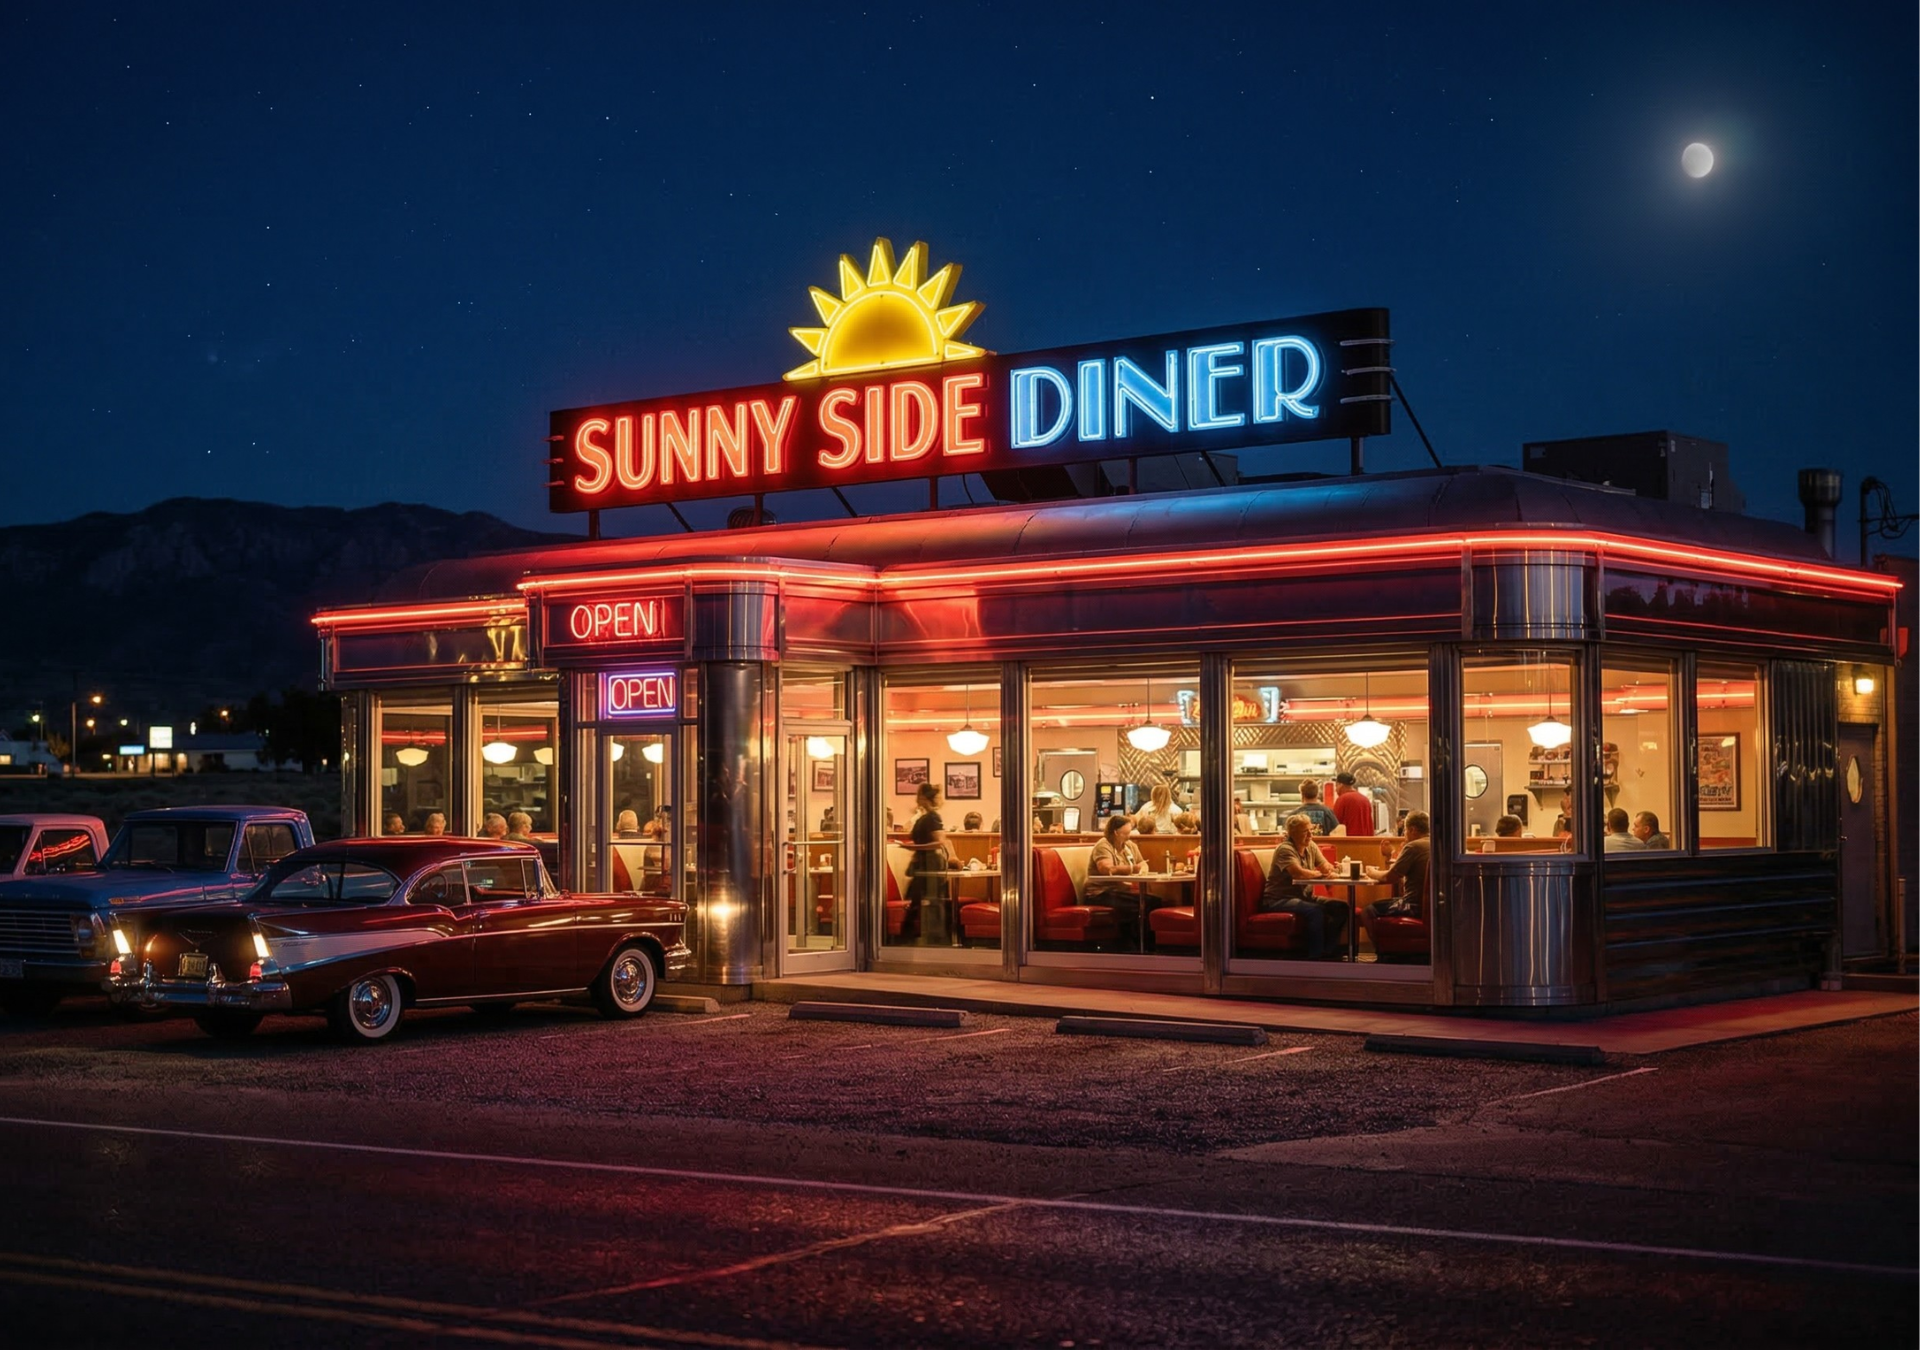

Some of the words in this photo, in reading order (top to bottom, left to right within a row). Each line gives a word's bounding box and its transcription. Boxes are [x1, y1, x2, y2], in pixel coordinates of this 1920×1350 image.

[574, 395, 797, 494] SUNNY
[818, 373, 986, 470] SIDE
[1010, 335, 1320, 449] DINER
[570, 601, 654, 638] OPEN
[611, 677, 673, 709] OPEN
